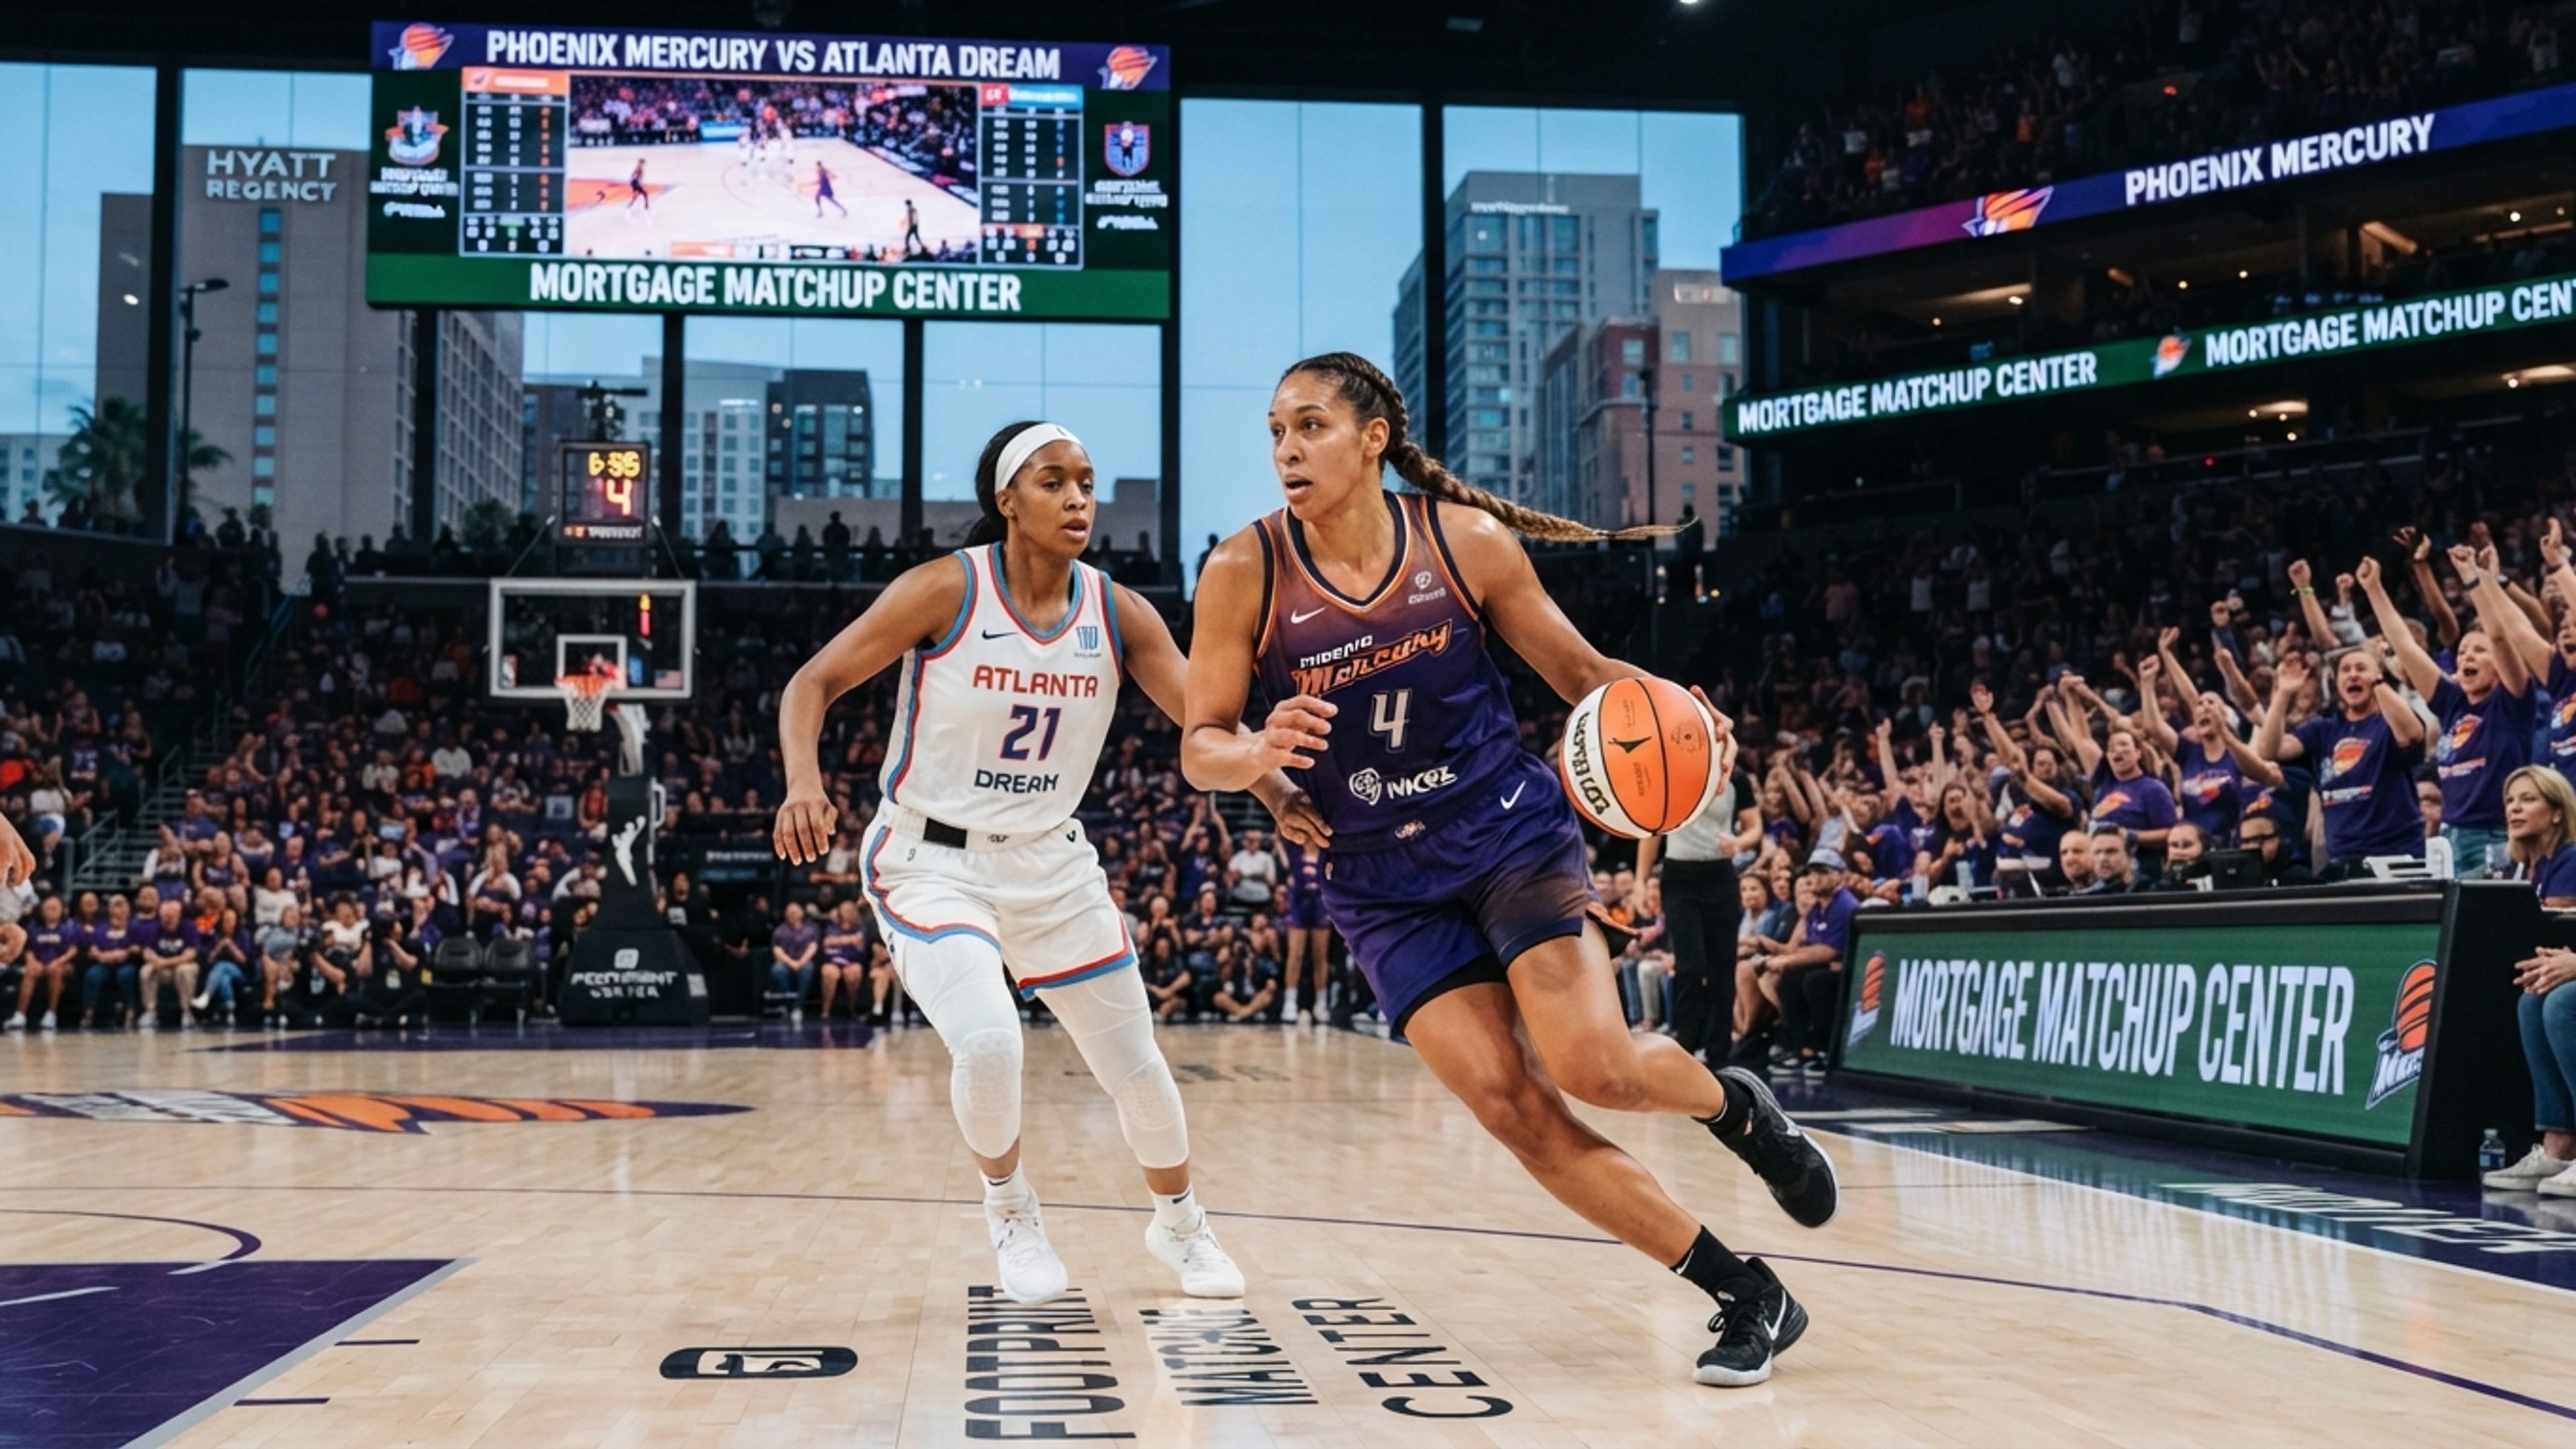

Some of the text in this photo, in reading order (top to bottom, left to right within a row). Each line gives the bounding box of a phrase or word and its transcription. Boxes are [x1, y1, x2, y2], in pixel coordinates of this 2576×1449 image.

[486, 30, 1060, 80] PHOENIX MERCURY VS ATLANTA DREAM
[207, 150, 337, 178] HYATT
[2124, 113, 2435, 205] PHOENIX MERCURY
[205, 179, 338, 202] REGENCY
[530, 262, 1022, 311] MORTGAGE MATCHUP CENTER
[2206, 278, 2576, 368] MORTGAGE MATCHUP CEN
[1738, 352, 2098, 435] MORTGAGE MATCHUP CENTER
[606, 478, 633, 517] 4
[972, 664, 1098, 698] ATLANTA
[999, 703, 1062, 761] 21
[1370, 688, 1412, 751] 4
[1890, 959, 2034, 1060] MORTGAGE
[2032, 961, 2197, 1076] MATCHUP
[2198, 964, 2355, 1095] CENTER
[1292, 1296, 1514, 1419] CENTER
